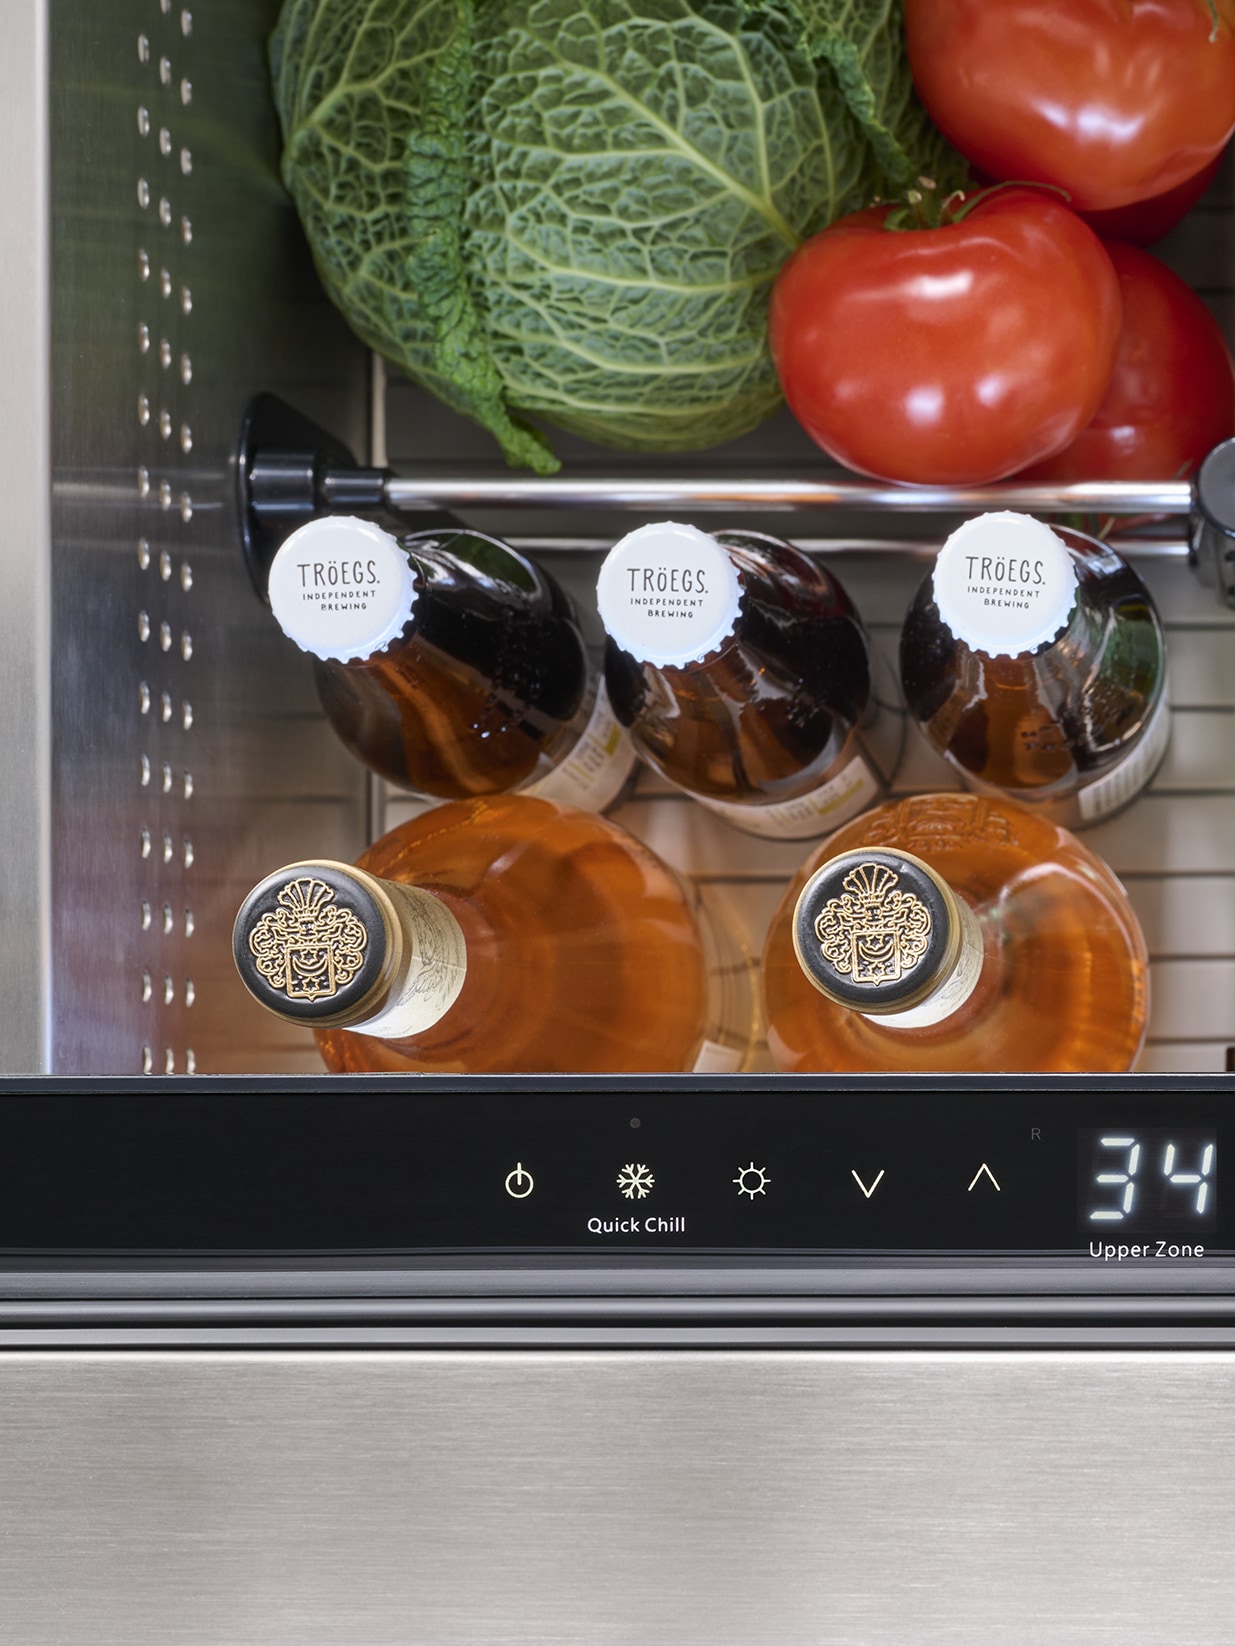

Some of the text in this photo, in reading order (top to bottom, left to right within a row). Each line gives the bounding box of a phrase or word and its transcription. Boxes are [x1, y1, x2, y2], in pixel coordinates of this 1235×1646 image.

[302, 590, 376, 601] INDEPENDENT
[967, 586, 1041, 598] INDEPENDENT
[321, 602, 368, 611] BREWING
[630, 597, 704, 607] INDEPENDENT
[983, 598, 1030, 609] BREWING
[647, 609, 694, 618] BREWING
[1031, 1128, 1042, 1141] R
[1090, 1137, 1214, 1221] 34
[587, 1217, 686, 1234] Quick Chill
[1089, 1241, 1205, 1262] Upper Zone
